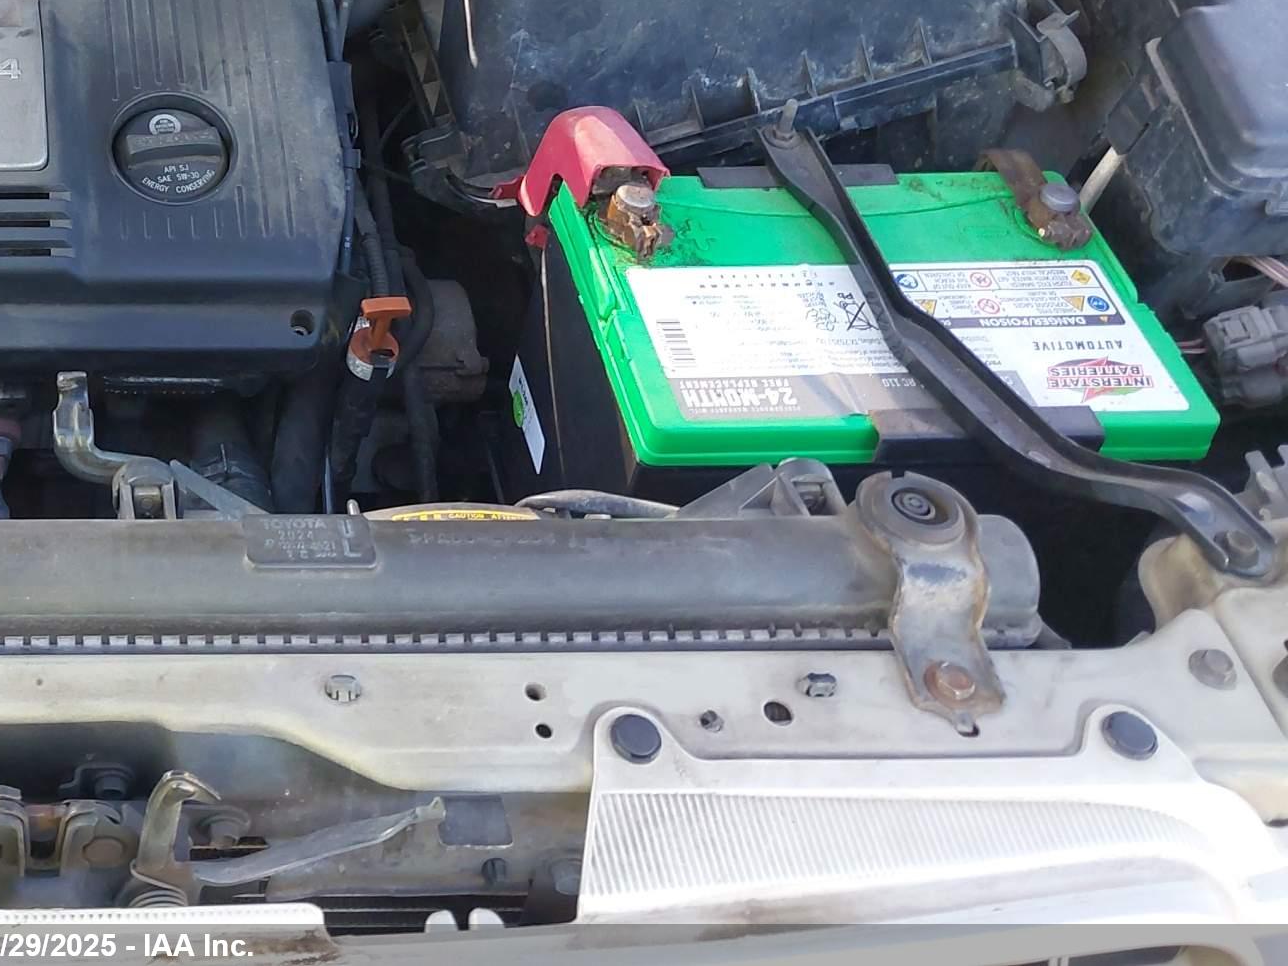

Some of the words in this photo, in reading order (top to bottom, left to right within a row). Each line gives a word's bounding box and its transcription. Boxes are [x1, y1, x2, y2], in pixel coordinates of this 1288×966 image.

[141, 177, 170, 193] ENERGY
[175, 169, 216, 194] CONSERVING
[837, 292, 854, 300] Pb
[979, 315, 1086, 327] DANGER/POISON
[1032, 339, 1123, 352] AUTOMOTIVE
[1049, 366, 1141, 377] BATTERIES
[679, 378, 759, 390] REPLACEMENT
[761, 377, 790, 388] FREE
[1047, 376, 1153, 388] INTERSTATE
[681, 387, 798, 408] 24-MONTH
[261, 518, 328, 530] TOYOTA
